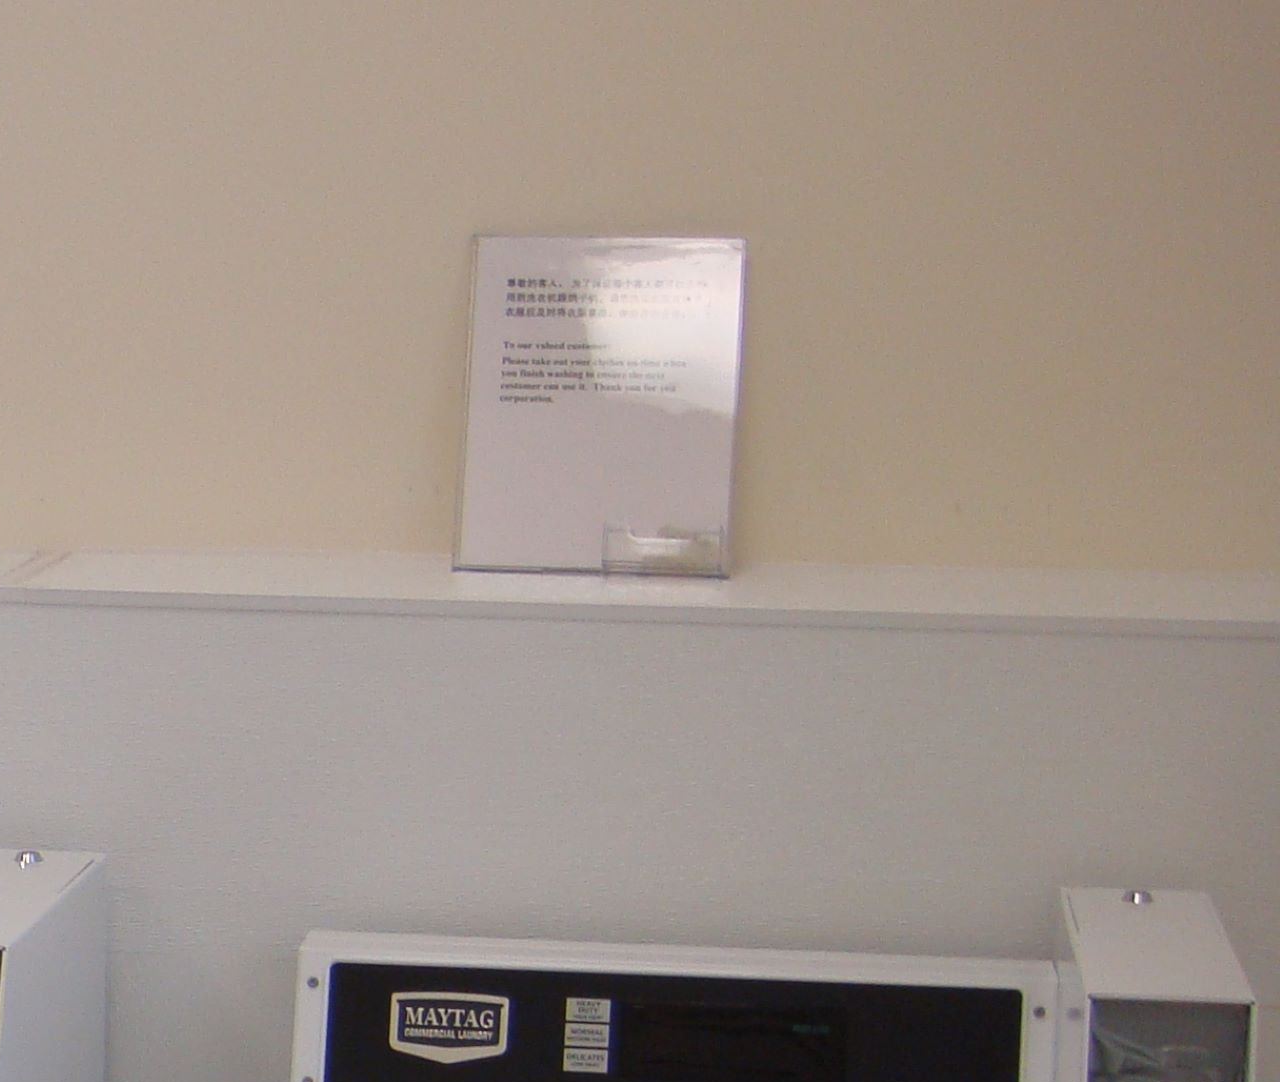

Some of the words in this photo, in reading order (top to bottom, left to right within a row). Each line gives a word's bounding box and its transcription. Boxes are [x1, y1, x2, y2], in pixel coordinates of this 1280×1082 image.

[405, 1006, 494, 1029] MAYTAG
[404, 1027, 456, 1039] COMMERCIAL
[457, 1029, 493, 1041] LAUNDRY
